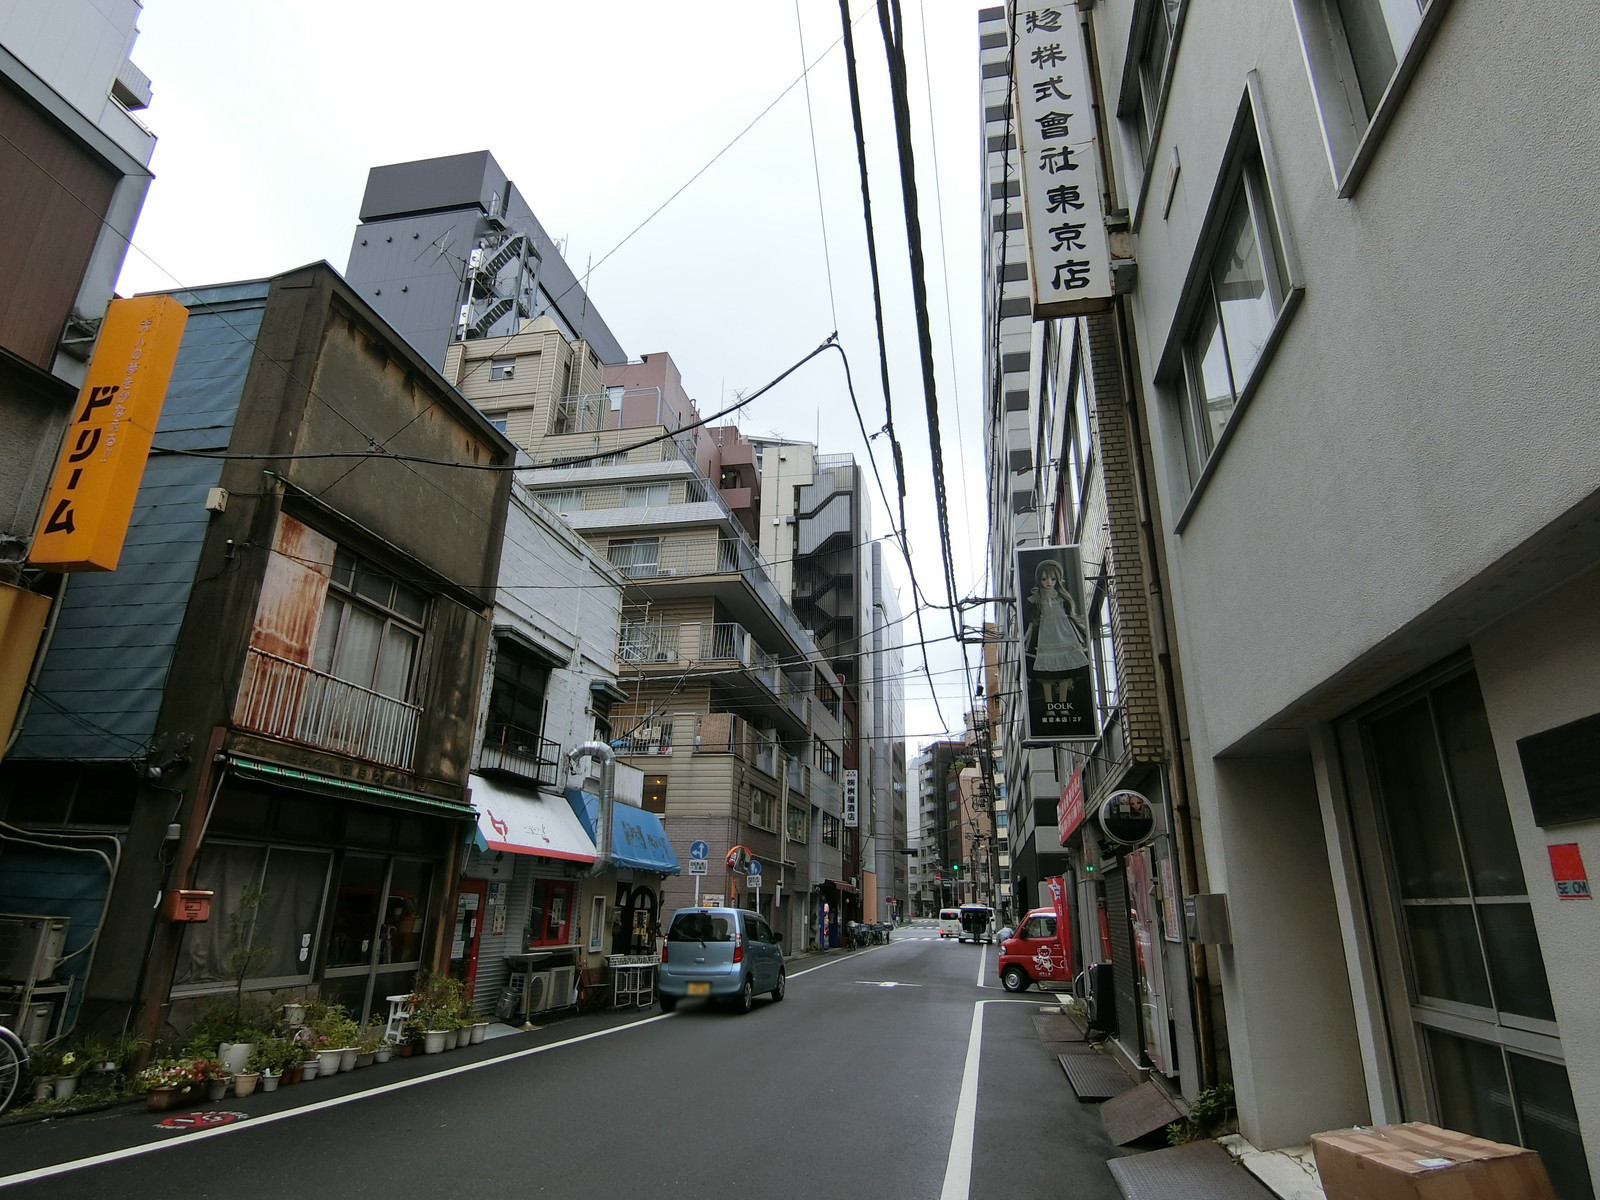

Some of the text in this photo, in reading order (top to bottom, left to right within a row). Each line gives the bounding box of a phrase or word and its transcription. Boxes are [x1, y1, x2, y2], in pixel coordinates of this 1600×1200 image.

[1025, 8, 1090, 291] 惣株式會社東京店
[43, 385, 120, 535] ドリーム
[1047, 702, 1074, 710] DOLK
